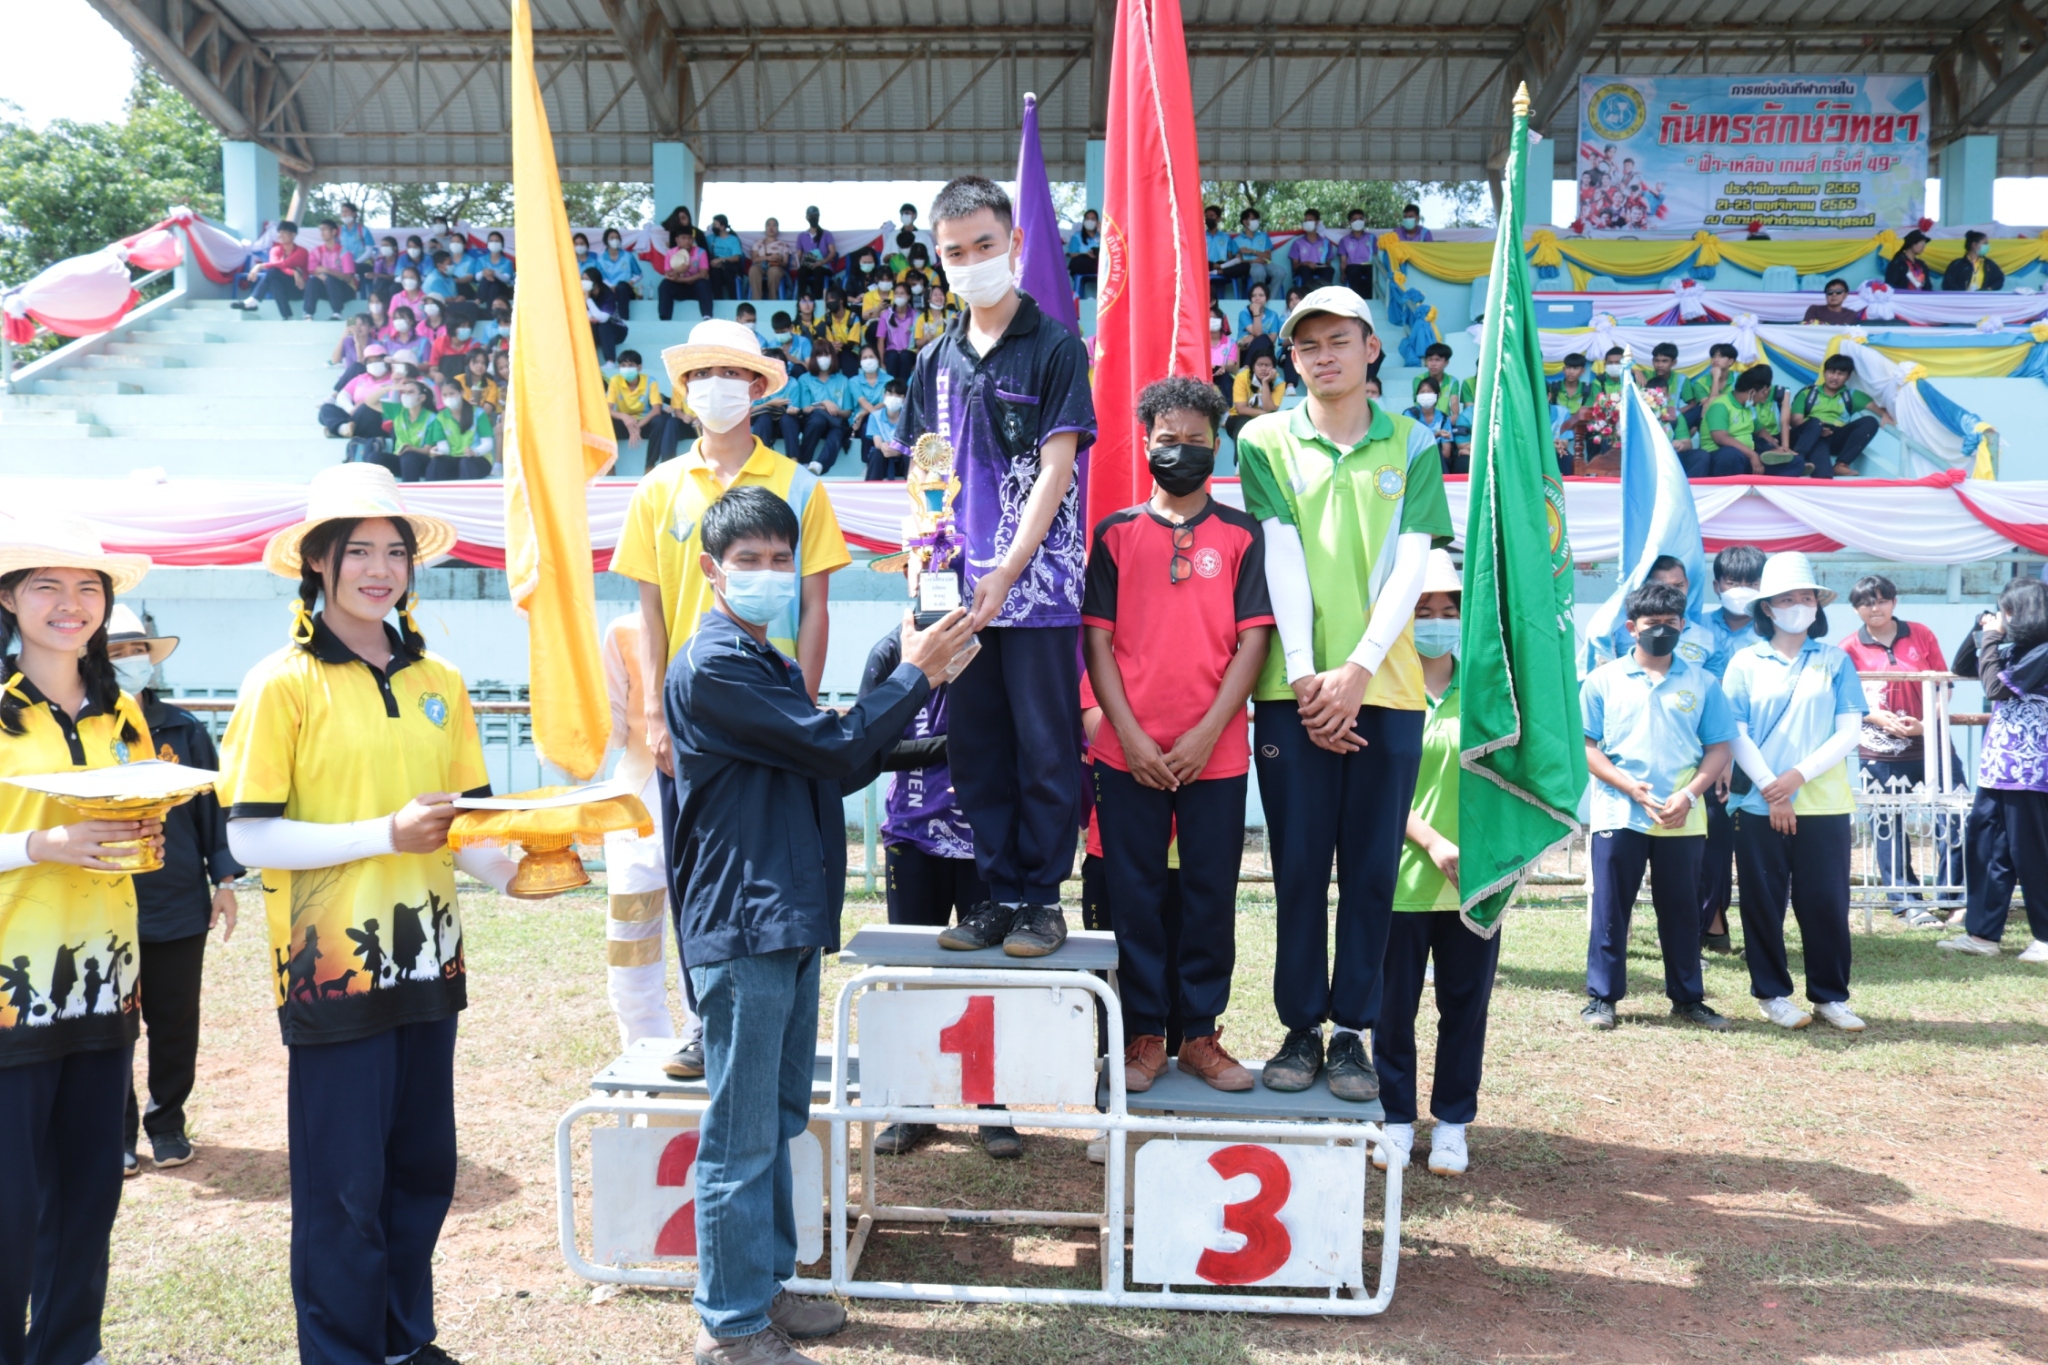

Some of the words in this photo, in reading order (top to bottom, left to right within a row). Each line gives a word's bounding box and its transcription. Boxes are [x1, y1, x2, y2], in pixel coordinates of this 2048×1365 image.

[1731, 82, 1854, 95] การแข่งขันกีฬาภายใน
[1659, 102, 1919, 144] กันทรลักษ์วิทยา
[1825, 182, 1860, 194] 2565
[1821, 198, 1856, 211] 2565
[939, 995, 995, 1104] 1
[1195, 1144, 1291, 1285] 3
